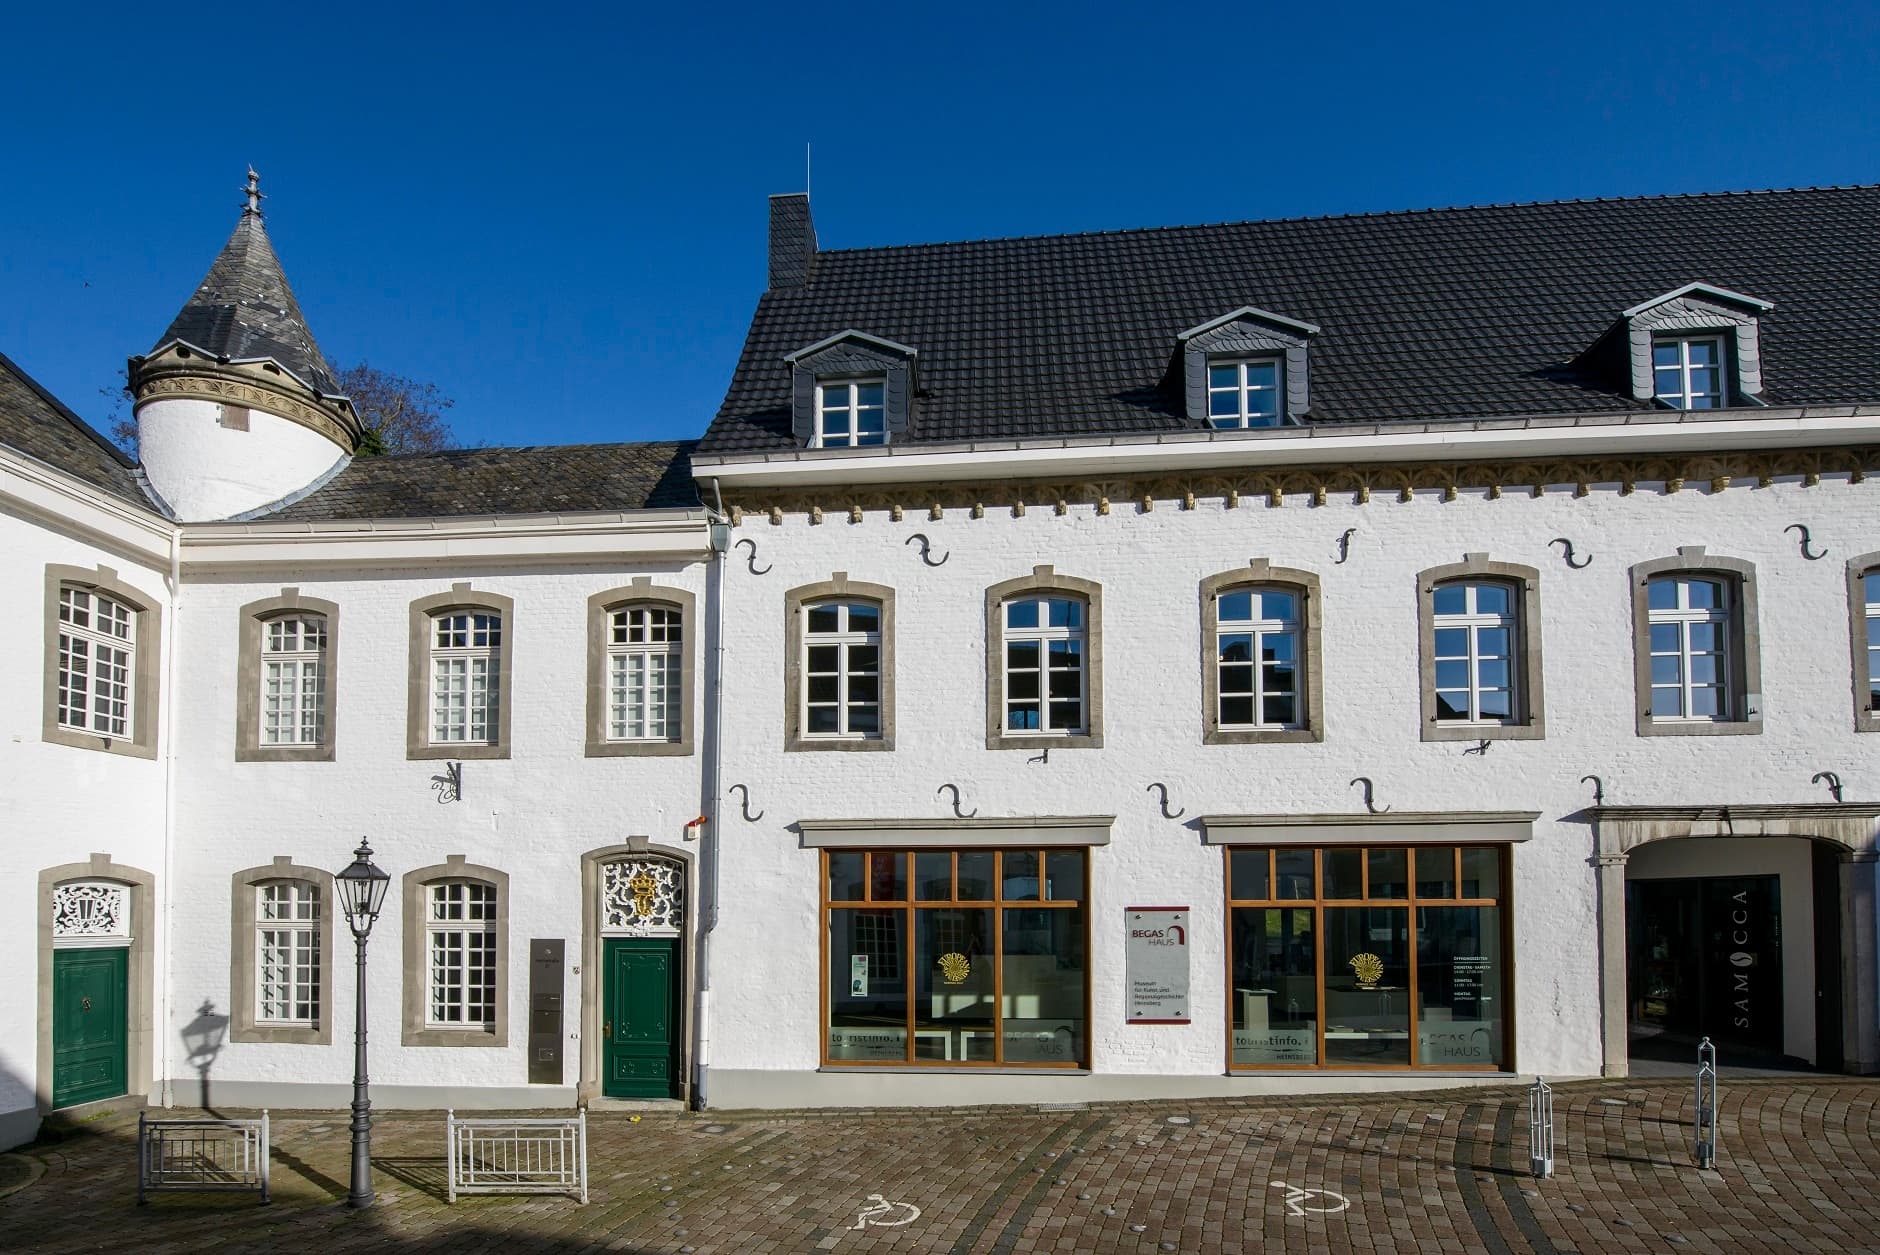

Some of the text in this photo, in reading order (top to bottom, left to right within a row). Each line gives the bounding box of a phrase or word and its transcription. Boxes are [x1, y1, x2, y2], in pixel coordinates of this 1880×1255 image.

[1132, 929, 1164, 938] BEGAS
[1731, 890, 1753, 1028] SAMOCCA
[1444, 1046, 1480, 1057] HAUS
